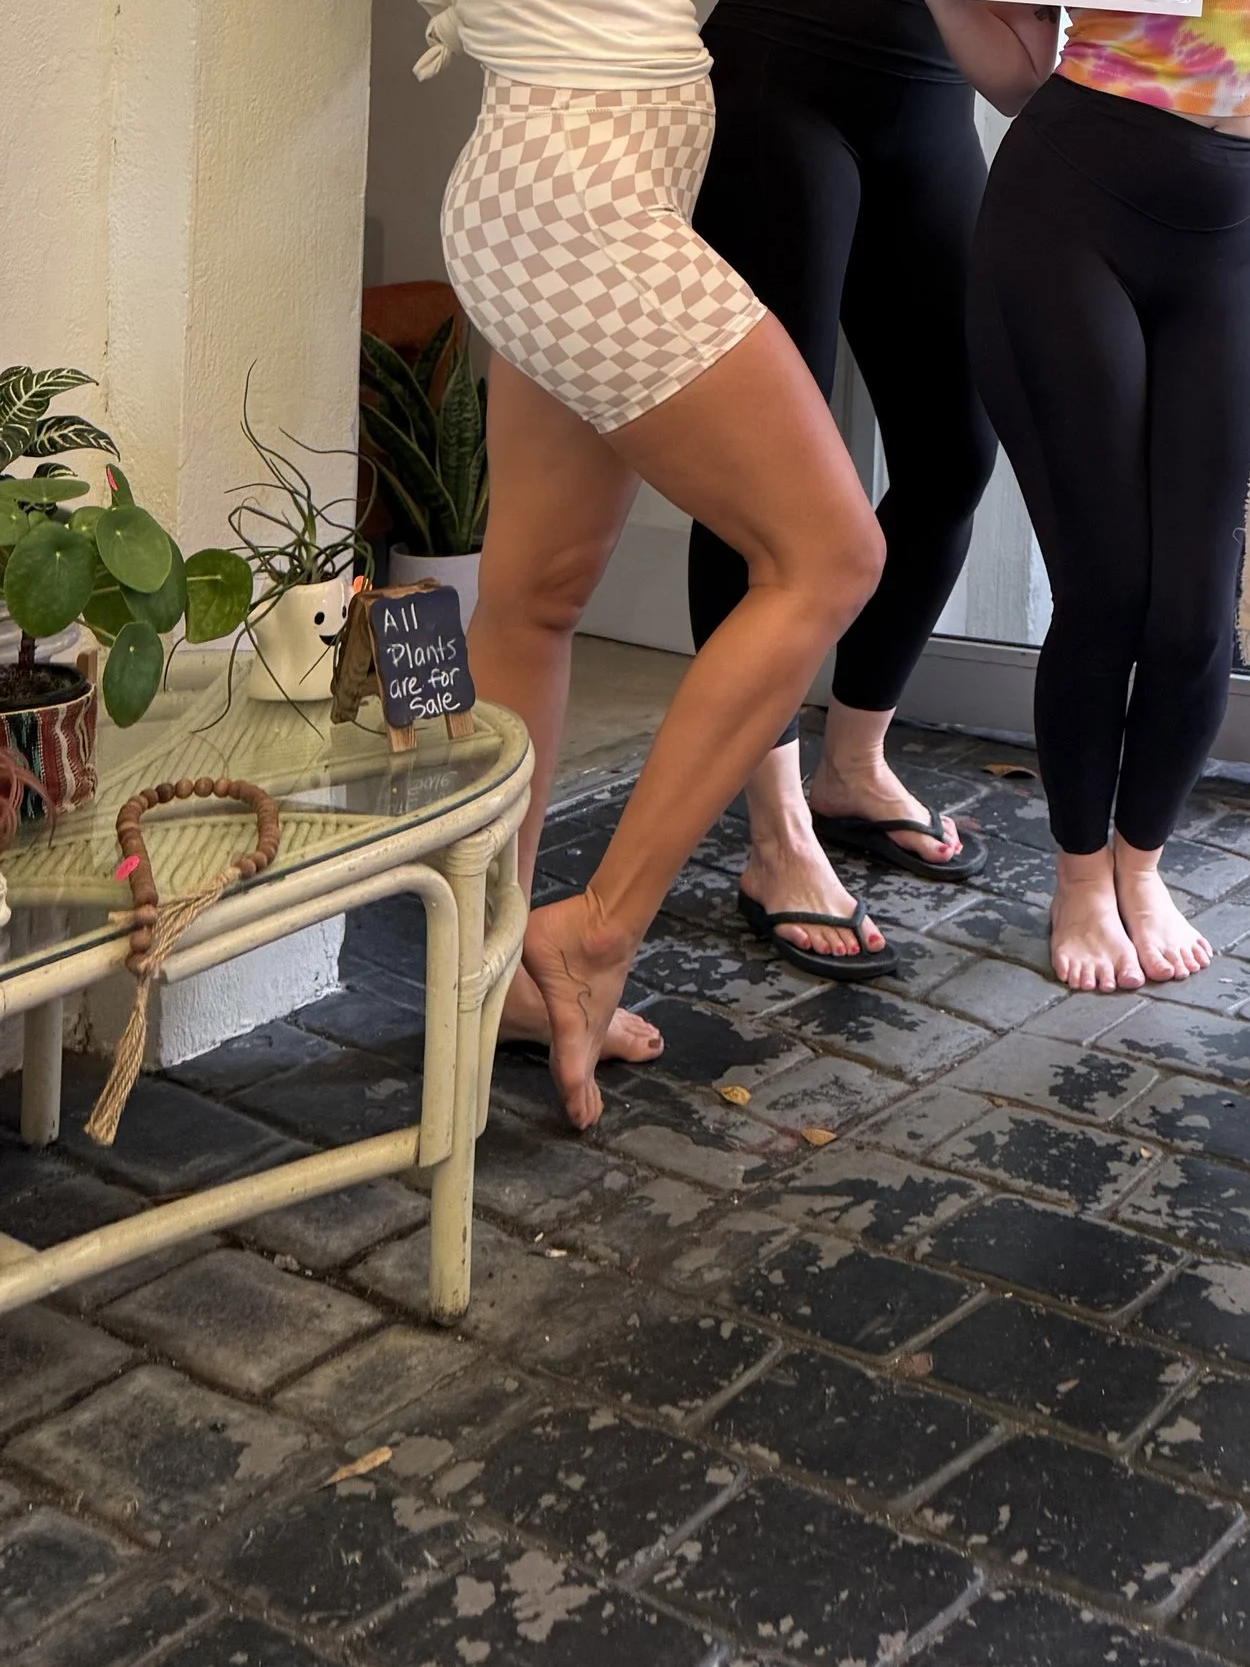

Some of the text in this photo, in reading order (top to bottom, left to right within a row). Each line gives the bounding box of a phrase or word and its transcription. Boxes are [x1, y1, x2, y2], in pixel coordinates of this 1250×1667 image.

[384, 603, 418, 633] All
[386, 635, 457, 669] Plants
[389, 667, 460, 699] are for
[410, 692, 461, 720] Sale
